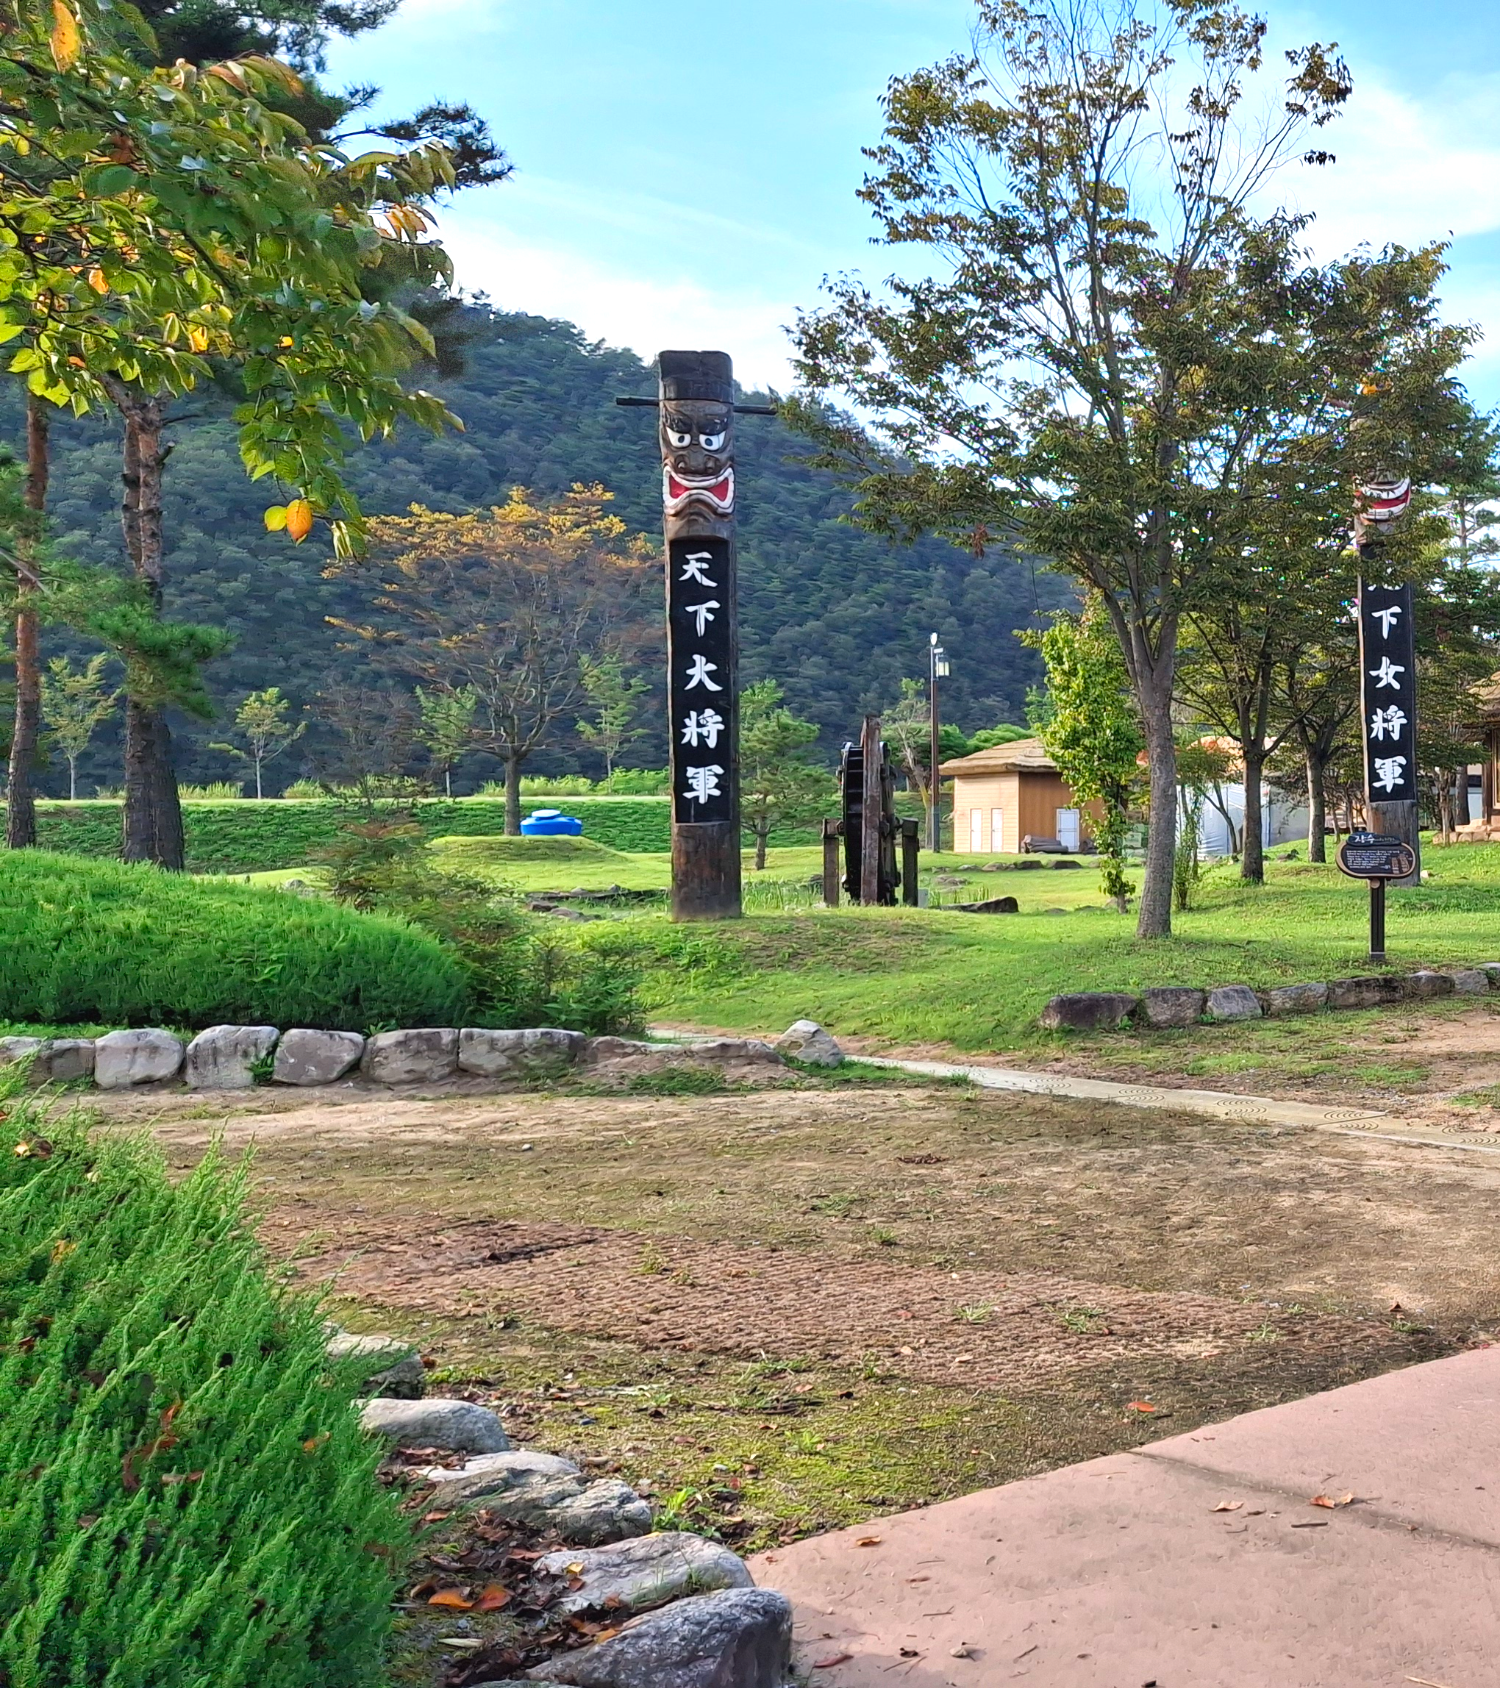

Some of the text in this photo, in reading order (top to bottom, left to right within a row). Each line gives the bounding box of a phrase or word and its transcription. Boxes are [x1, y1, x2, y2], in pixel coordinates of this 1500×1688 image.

[678, 551, 726, 805] 天下大將軍
